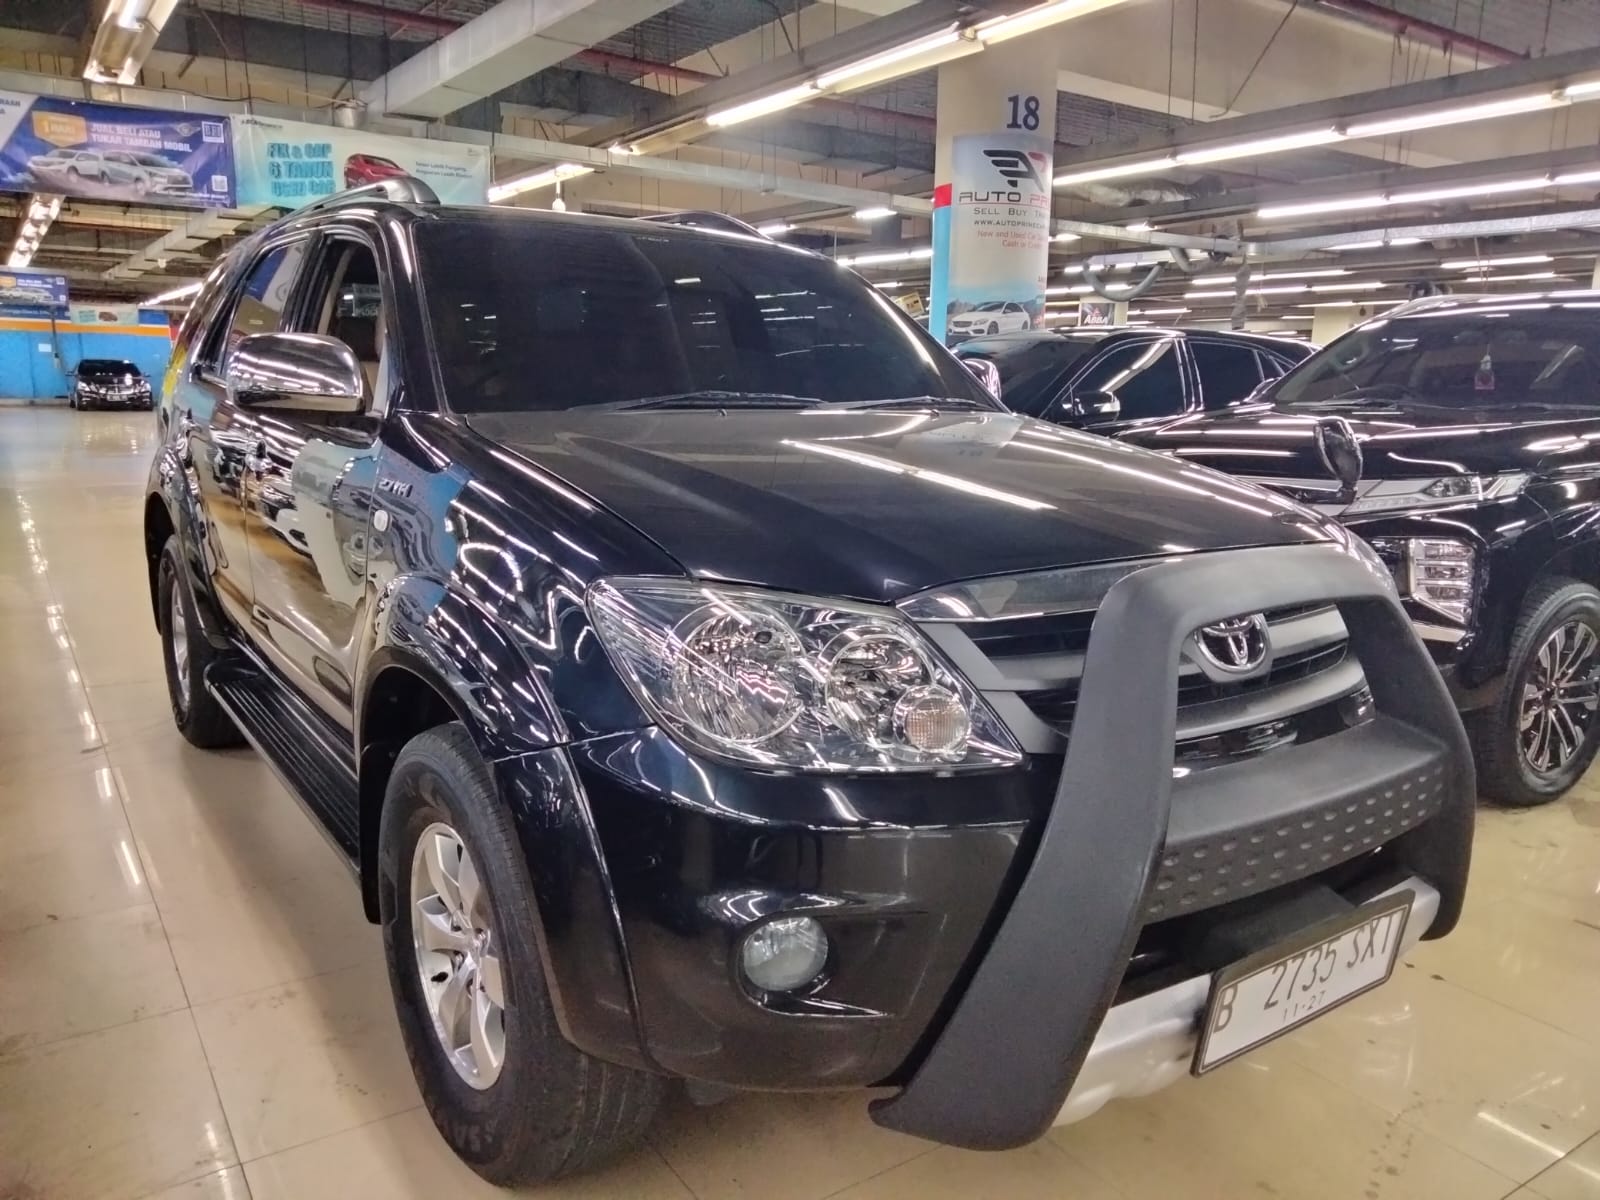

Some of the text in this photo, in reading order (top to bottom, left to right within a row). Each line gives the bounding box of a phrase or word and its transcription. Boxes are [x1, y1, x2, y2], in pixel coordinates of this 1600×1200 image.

[1007, 94, 1039, 131] 18
[164, 141, 193, 153] MOBIL
[959, 191, 1022, 203] AUTO
[973, 207, 1001, 216] SELL
[1213, 983, 1238, 1034] B
[1264, 936, 1341, 1010] 2735
